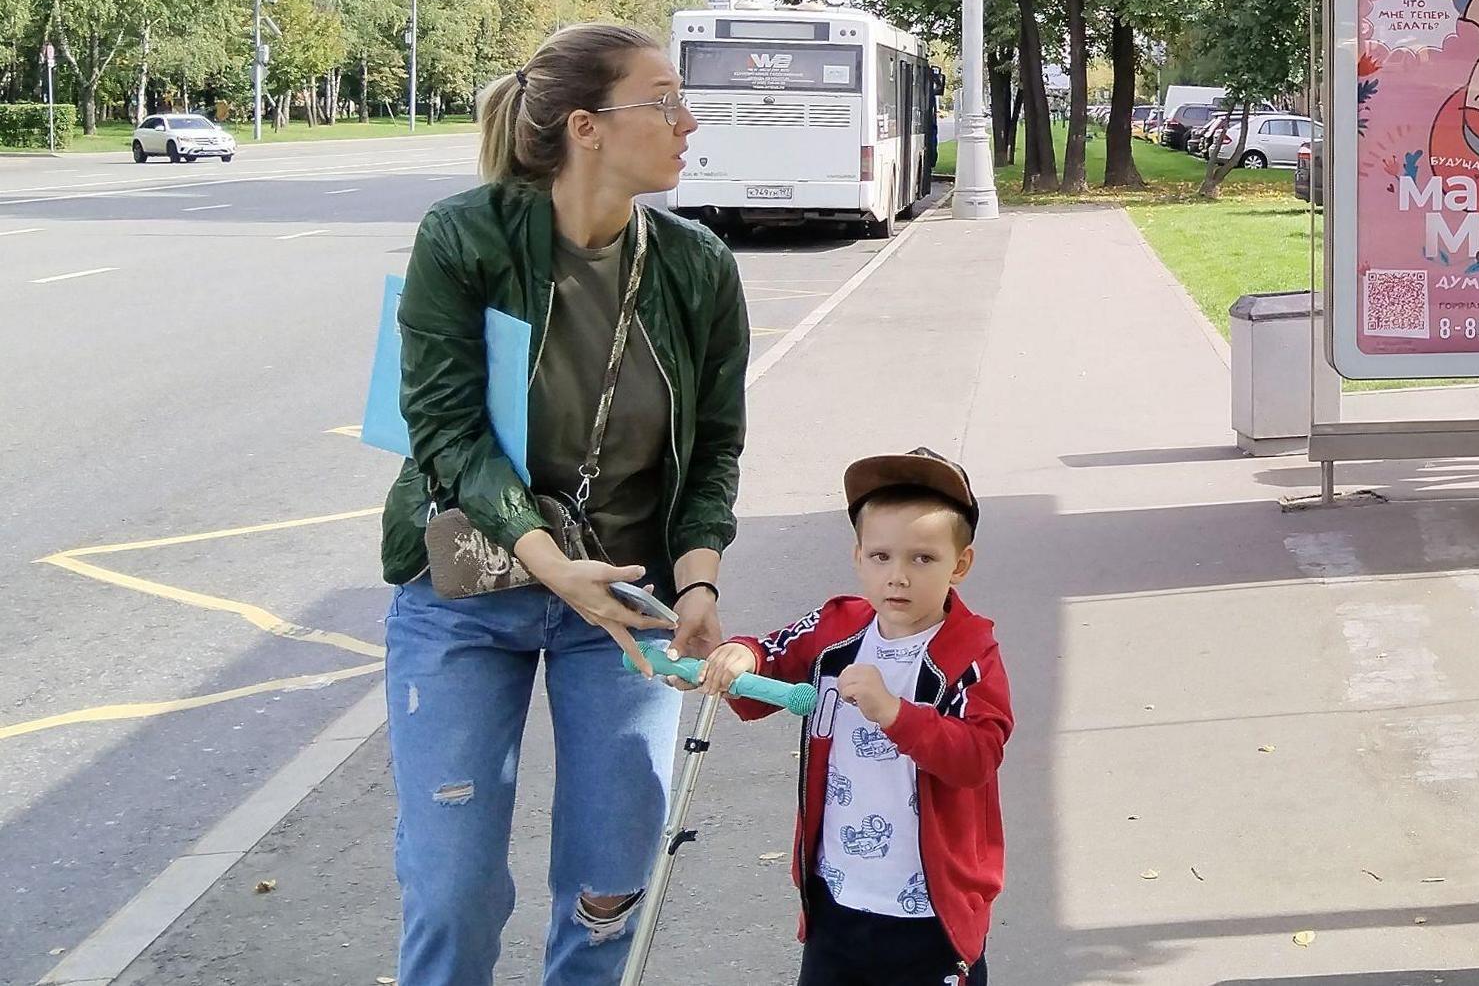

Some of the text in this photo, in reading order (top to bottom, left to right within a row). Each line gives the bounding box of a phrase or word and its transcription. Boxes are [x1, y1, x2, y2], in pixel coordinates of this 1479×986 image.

[1403, 0, 1425, 8] ЧТО
[1379, 10, 1450, 20] МНЕ ТЕПЕРЬ
[1388, 21, 1440, 31] ДЕЛАТЬ?
